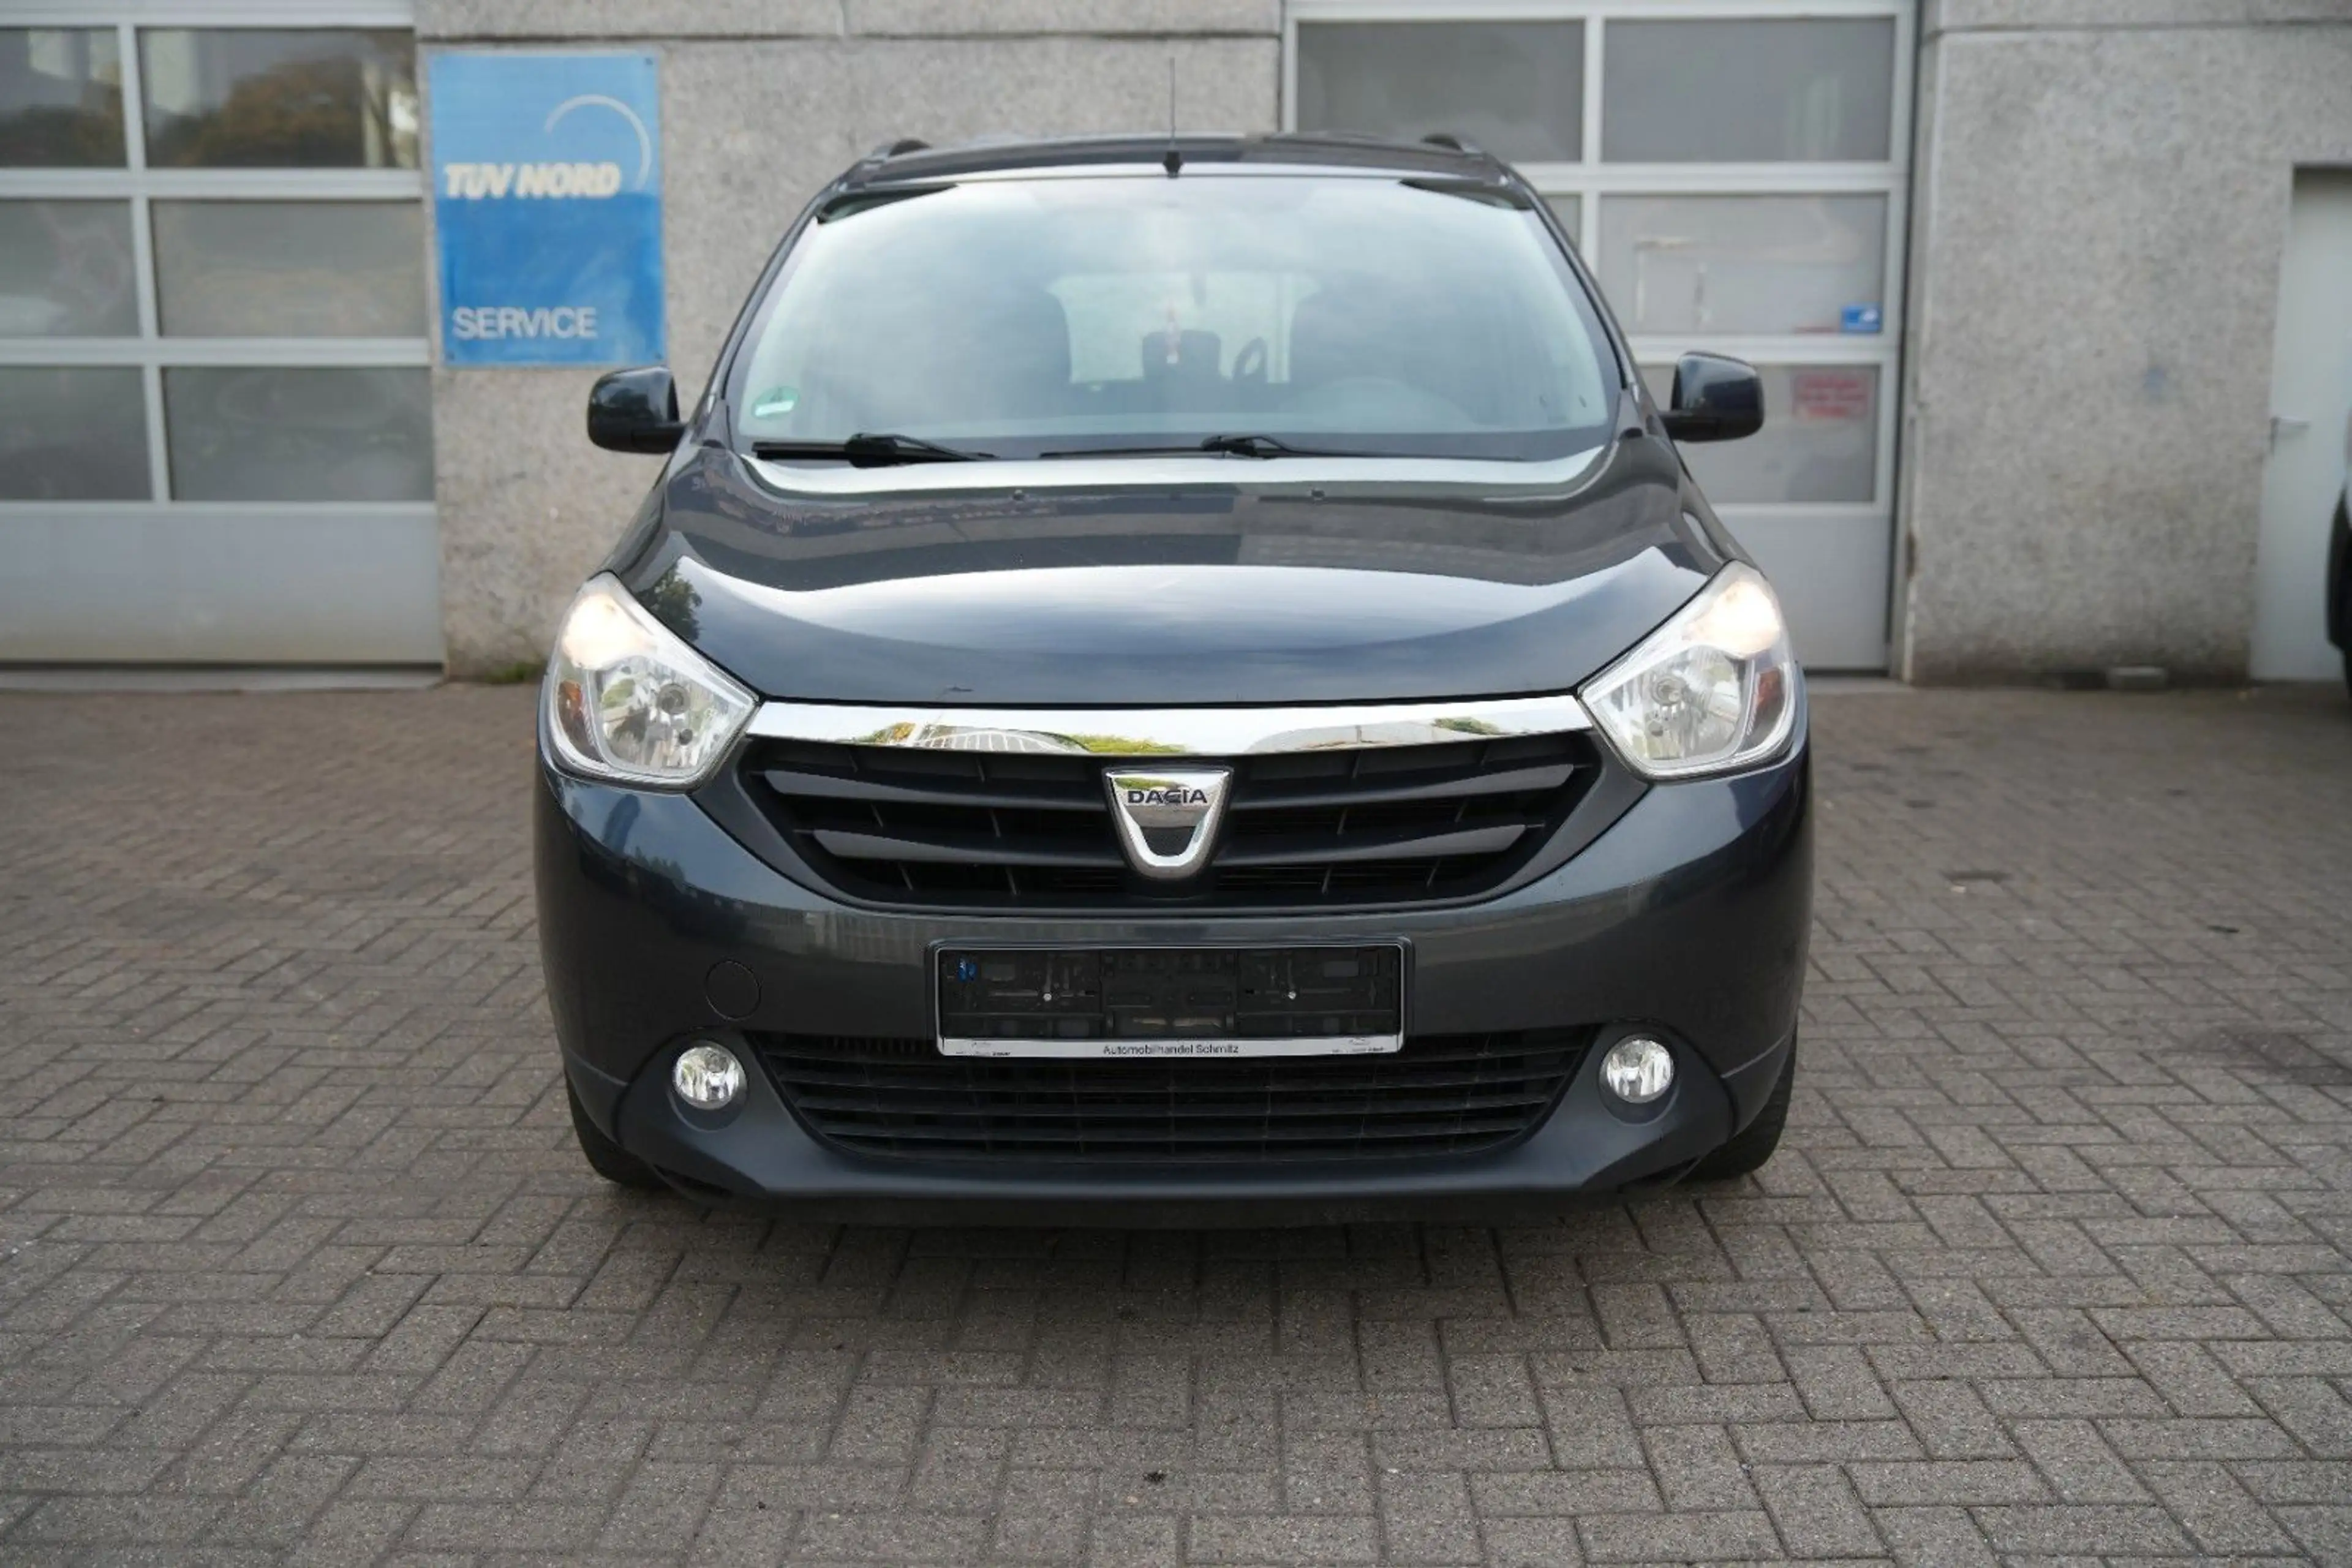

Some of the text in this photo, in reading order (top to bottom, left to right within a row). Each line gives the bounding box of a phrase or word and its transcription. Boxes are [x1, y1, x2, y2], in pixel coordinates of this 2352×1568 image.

[516, 162, 621, 197] NORD
[453, 307, 598, 339] SERVICE
[1128, 789, 1207, 804] DACIA
[1196, 1044, 1239, 1054] Schmitz
